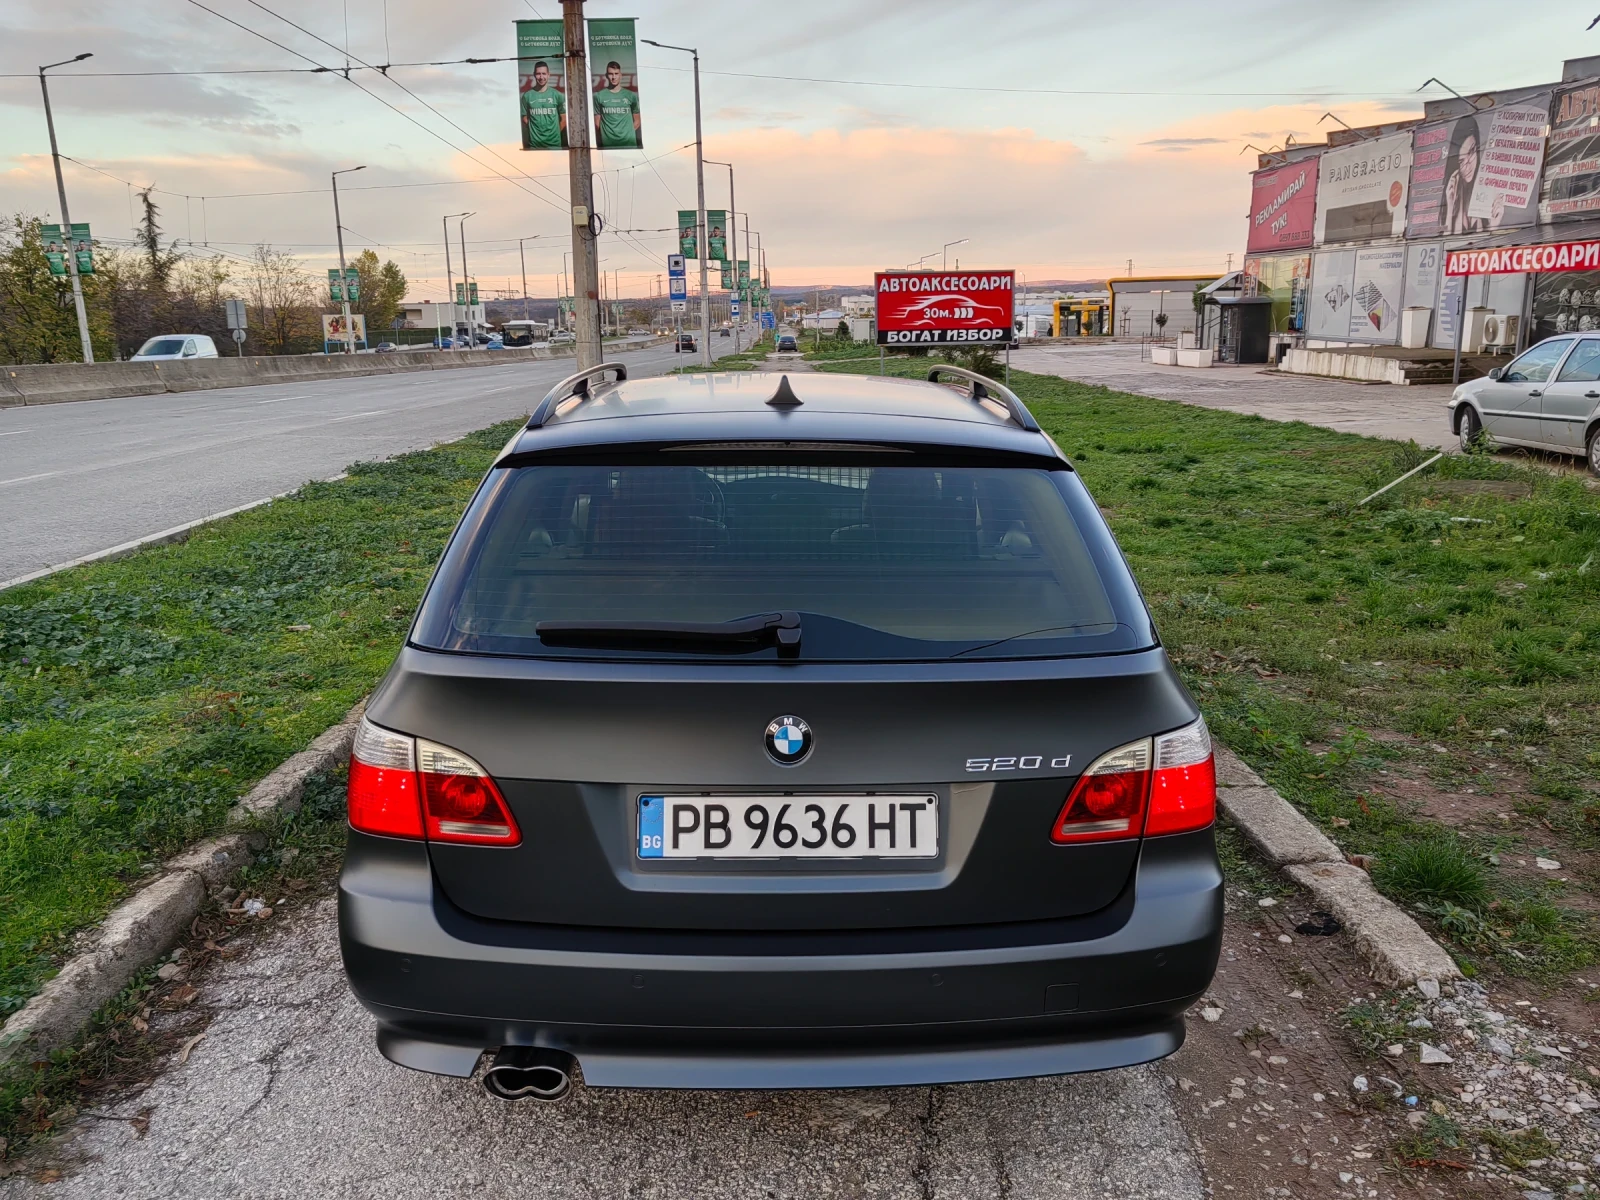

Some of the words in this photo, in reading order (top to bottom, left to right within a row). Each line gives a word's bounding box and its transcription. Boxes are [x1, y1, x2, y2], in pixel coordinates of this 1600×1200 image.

[530, 107, 556, 115] WINBET
[1556, 86, 1600, 126] АВТ
[1526, 113, 1546, 122] УСЛУГИ
[1496, 125, 1522, 135] ГРАФИЧЕН
[1495, 139, 1515, 149] ПЕЧАТНА
[1516, 141, 1540, 152] РЕКЛАМА
[1512, 156, 1536, 165] РЕКЛАМА
[1329, 153, 1402, 183] PANCRACIO
[1485, 164, 1510, 176] РЕКЛАМНИ
[1510, 169, 1535, 180] СУВЕНИРИ
[1358, 181, 1382, 190] CHOCOLATE
[1484, 178, 1508, 189] ФИРМЕНИ
[1509, 181, 1528, 192] ПЕЧАТИ
[1256, 170, 1306, 227] РЕКЛАМИРАЙ
[1505, 194, 1526, 206] ТЕНИСКИ
[1271, 212, 1287, 235] ТУК!
[1419, 248, 1436, 268] 25
[1448, 243, 1600, 273] АВТОАКСЕСОАРИ
[879, 276, 1011, 292] АВТОАКСЕСОАРИ
[923, 308, 952, 318] 30м.
[887, 330, 941, 342] БОГАТ
[946, 329, 1003, 341] ИЗБОР
[770, 718, 808, 732] BMW
[965, 756, 1042, 772] 520
[1051, 754, 1072, 768] d
[672, 804, 732, 850] PB
[744, 804, 856, 850] 9636
[868, 803, 927, 848] HT
[642, 835, 662, 849] BG
